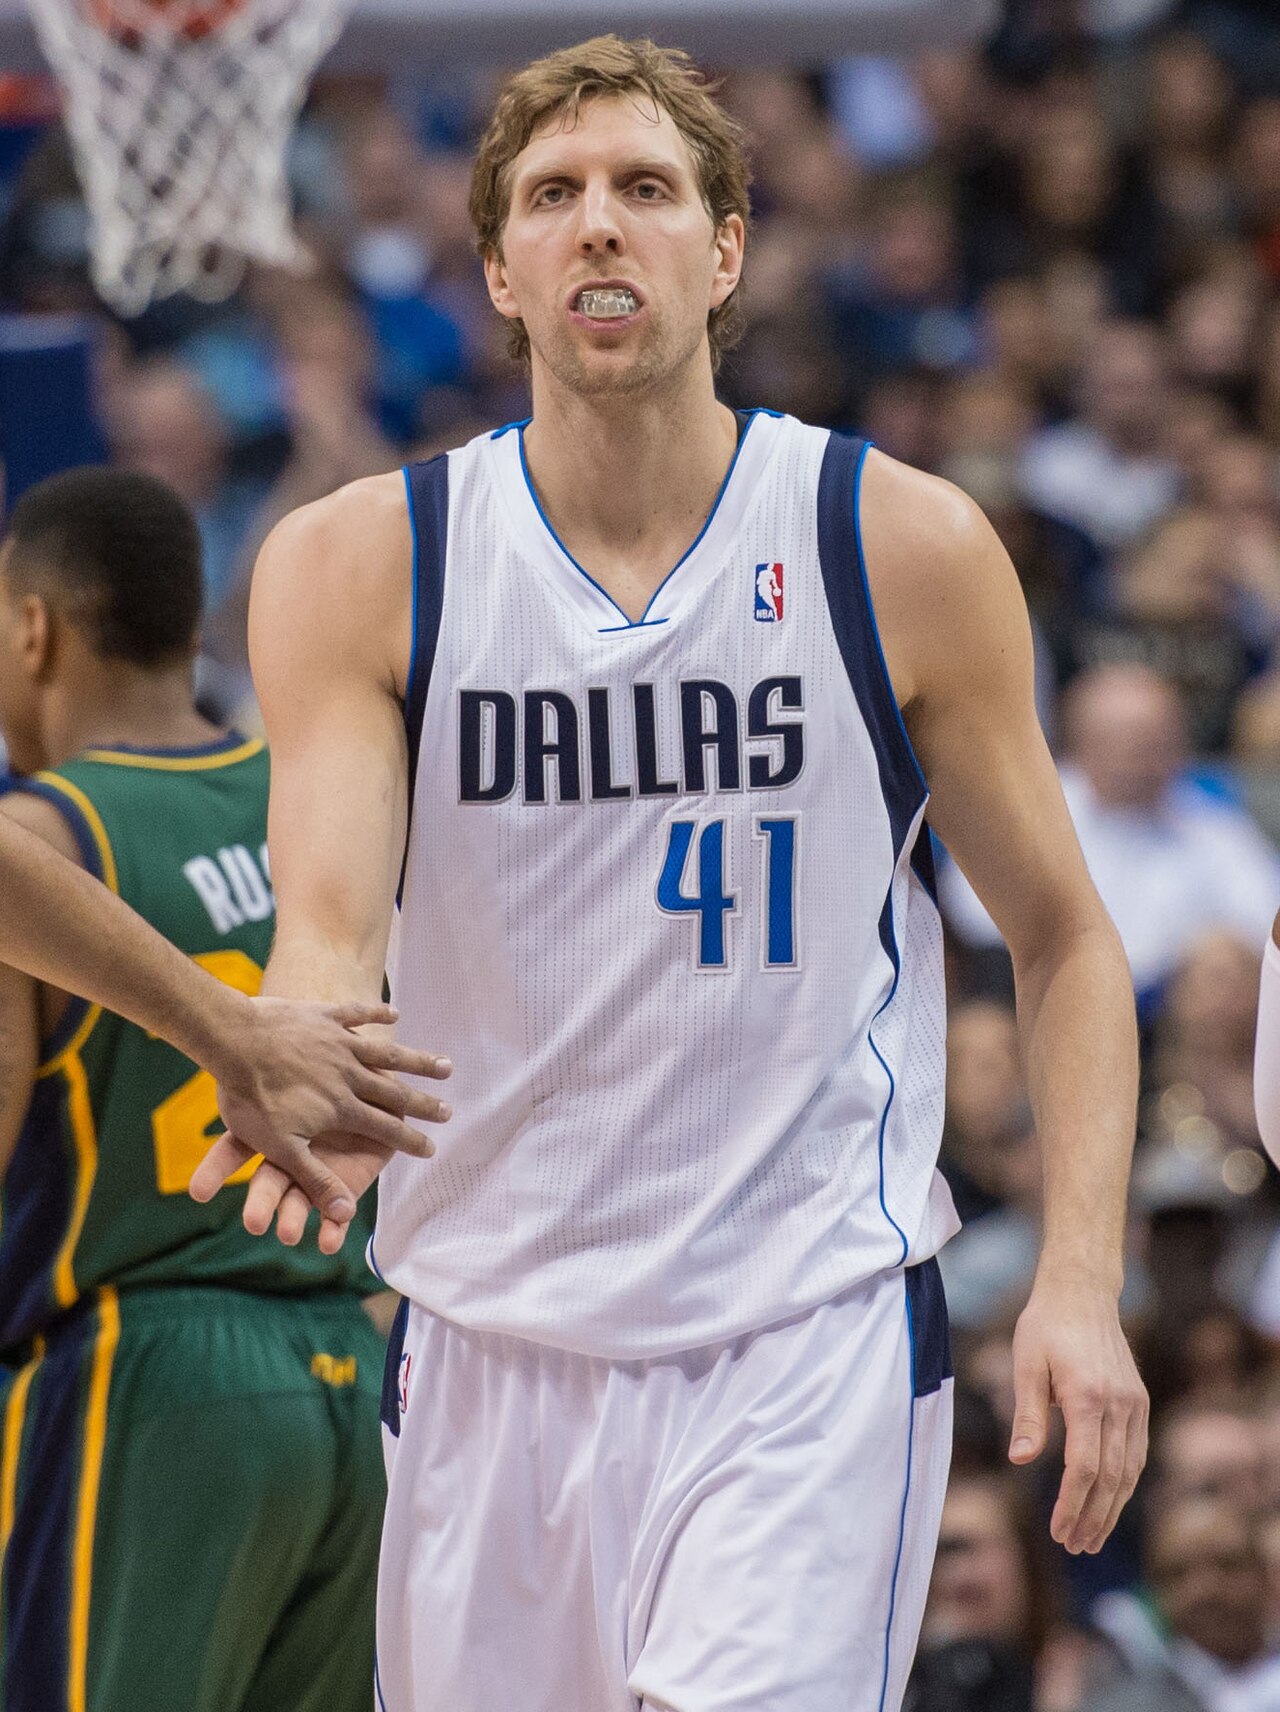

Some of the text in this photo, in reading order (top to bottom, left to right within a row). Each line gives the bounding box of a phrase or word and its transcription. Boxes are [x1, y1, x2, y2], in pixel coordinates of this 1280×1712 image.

[457, 675, 805, 806] DALLAS
[183, 842, 275, 935] RU
[654, 813, 800, 971] 41
